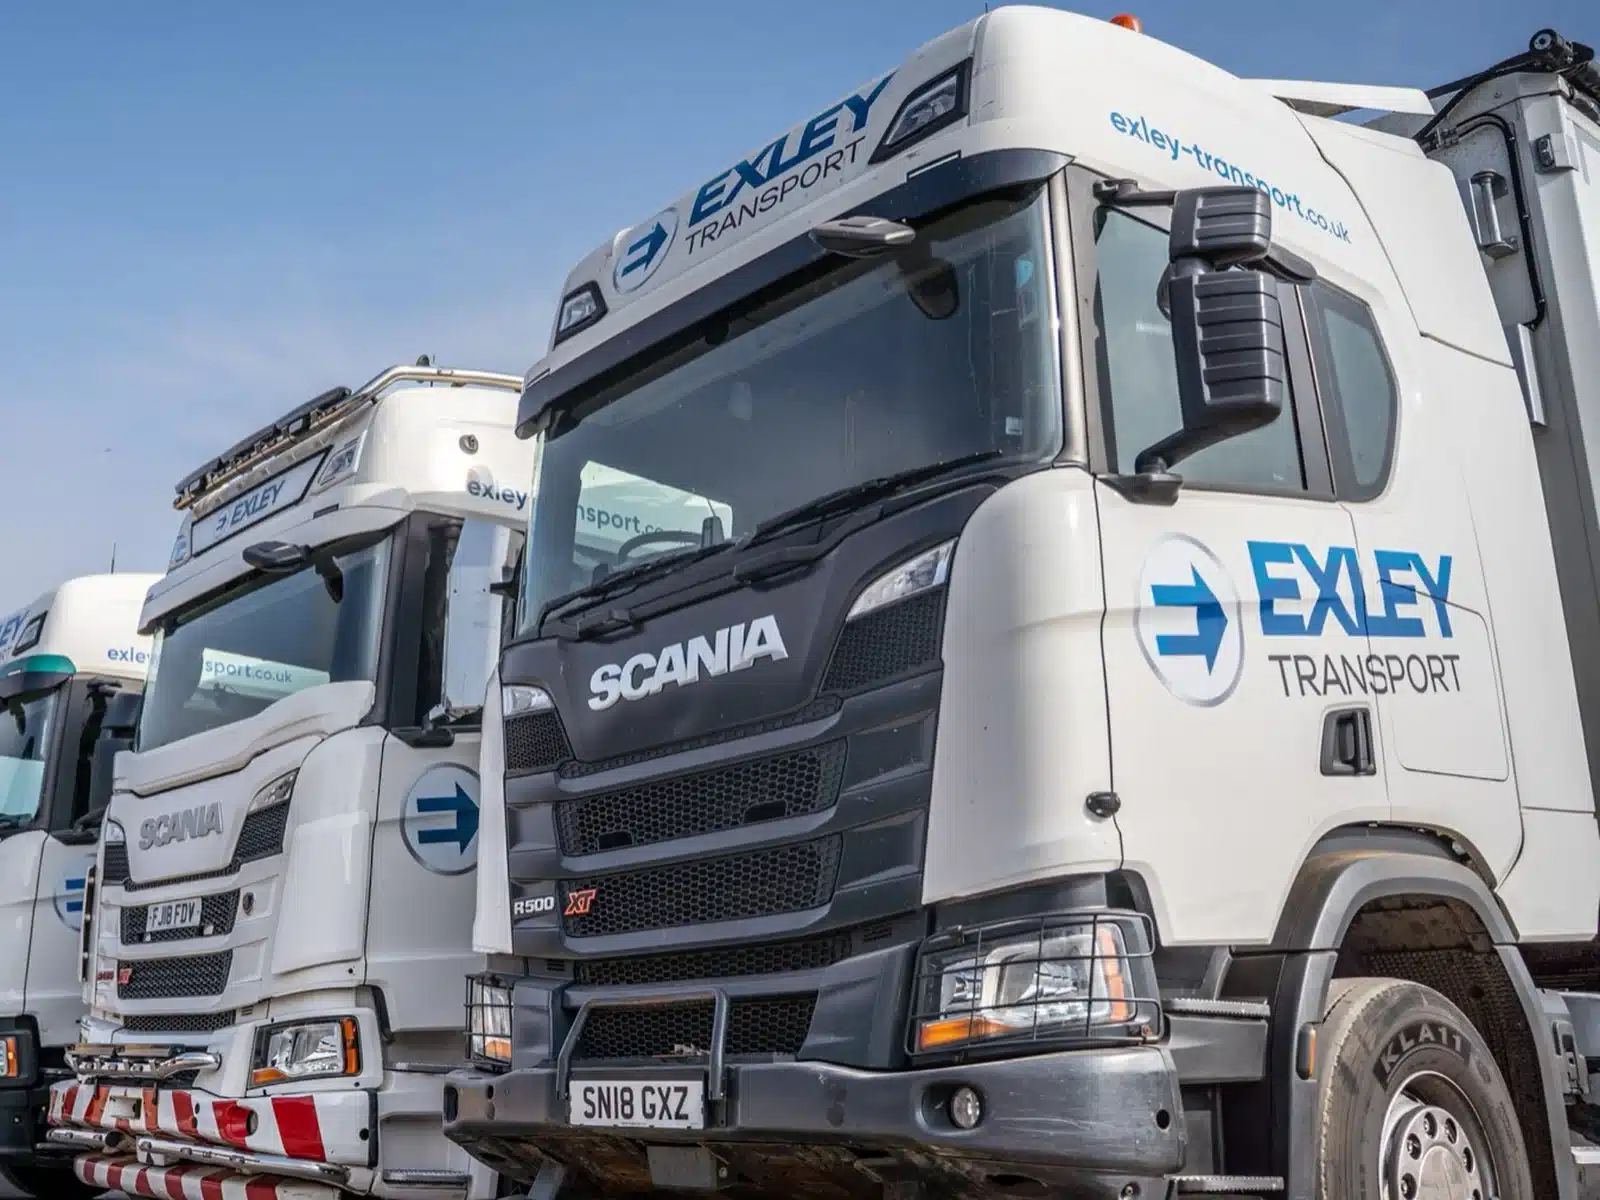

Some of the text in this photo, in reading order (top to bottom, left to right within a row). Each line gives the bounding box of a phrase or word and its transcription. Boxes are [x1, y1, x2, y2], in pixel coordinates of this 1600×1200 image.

[688, 71, 897, 228] EXLEY
[685, 136, 865, 255] TRANSPORT
[230, 479, 286, 528] EXLEY
[1246, 540, 1453, 638] EXLEY
[107, 646, 151, 664] exle
[587, 614, 789, 711] SCANIA
[1268, 655, 1461, 698] TRANSPORT
[138, 800, 223, 851] SCANIA
[514, 888, 598, 916] R500 XT
[583, 1086, 689, 1120] SN18 GXZ
